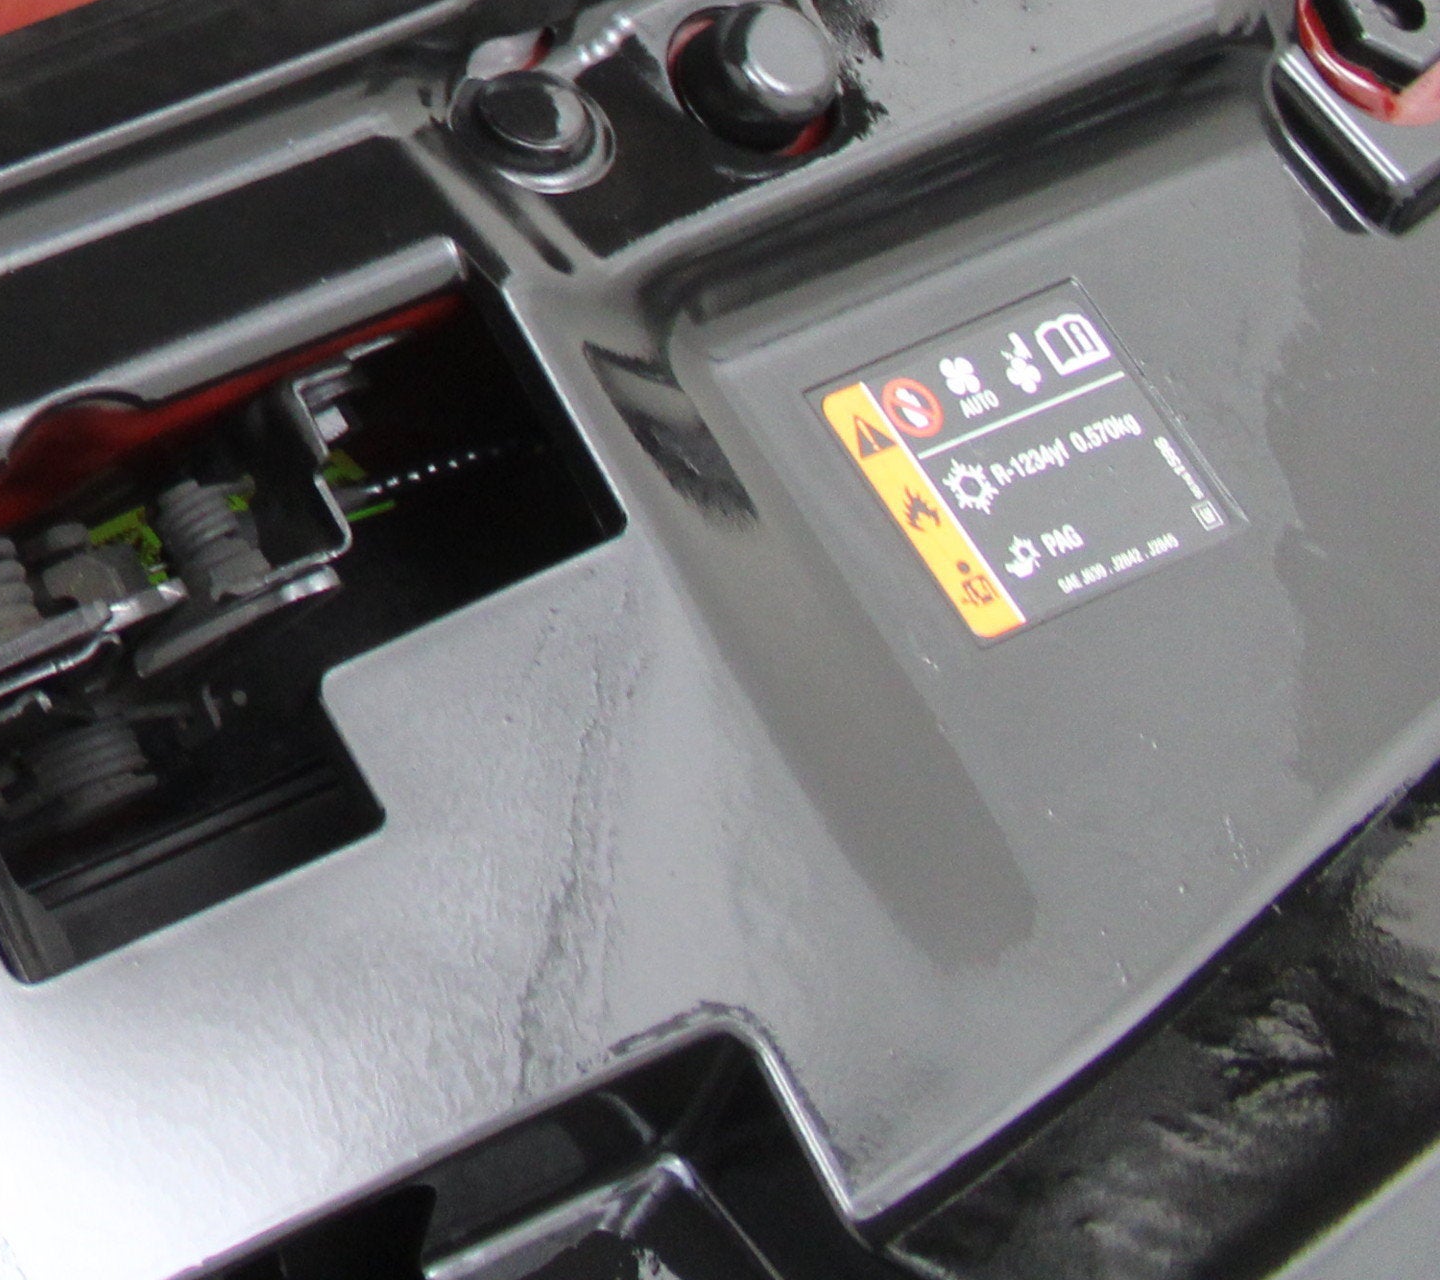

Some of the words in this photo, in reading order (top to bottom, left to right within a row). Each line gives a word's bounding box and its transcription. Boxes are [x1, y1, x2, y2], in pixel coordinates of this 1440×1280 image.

[959, 389, 1000, 419] AUTO
[1069, 413, 1142, 454] 0.570kg
[1040, 523, 1084, 557] PAG
